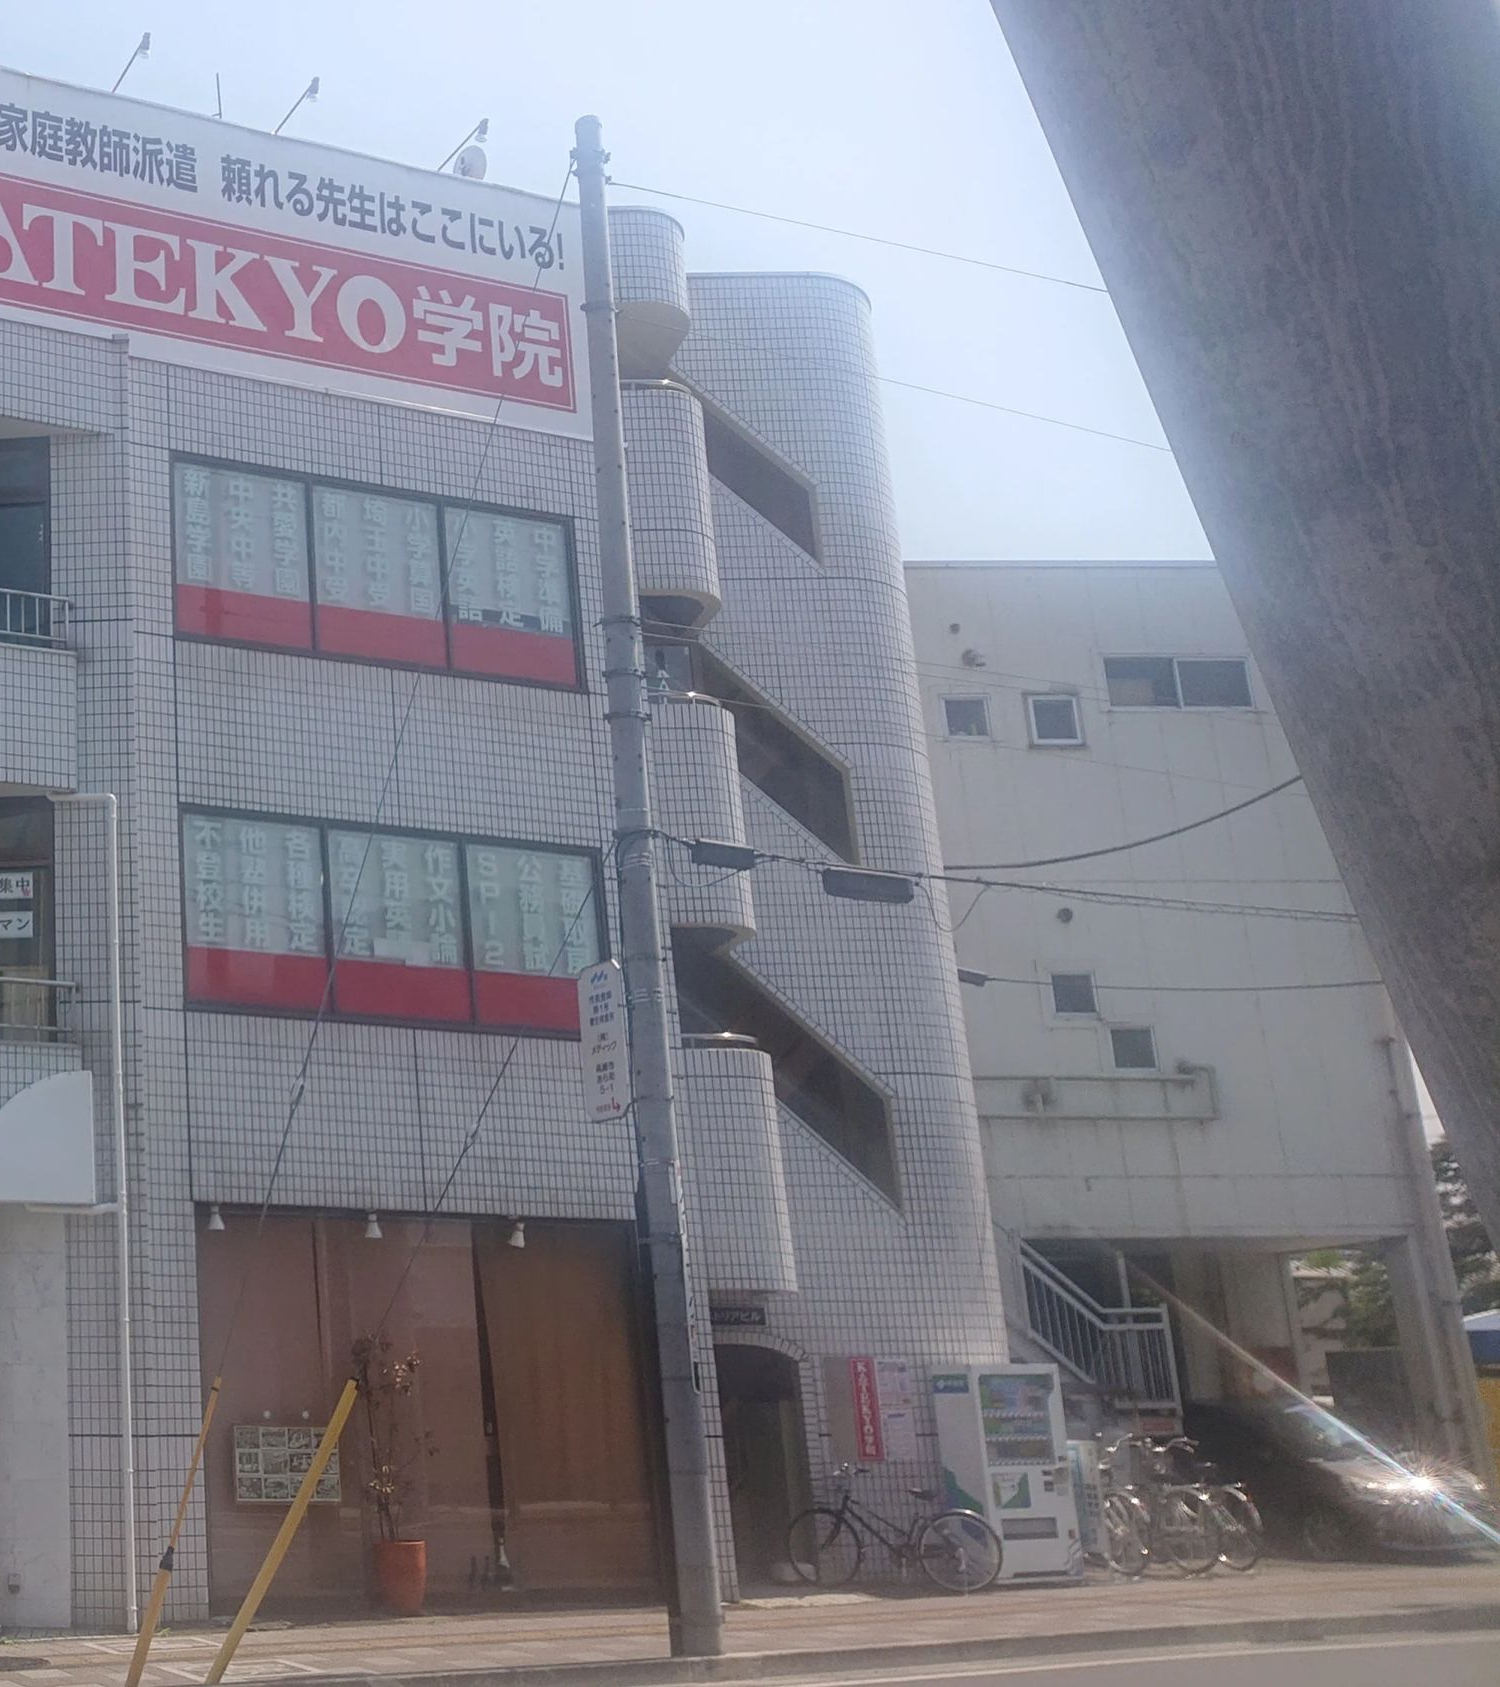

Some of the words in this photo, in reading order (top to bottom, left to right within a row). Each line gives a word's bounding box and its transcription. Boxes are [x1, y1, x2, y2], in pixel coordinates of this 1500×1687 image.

[221, 153, 566, 271] 頼れる先生はここにいる!
[184, 468, 212, 581] 新島学園
[228, 478, 255, 589] 中央中等
[194, 820, 225, 942] 不登校生
[240, 825, 270, 948] 他塾併用
[381, 841, 413, 946] 実用英
[425, 843, 458, 965] 作文小論
[476, 851, 505, 966] SPI2
